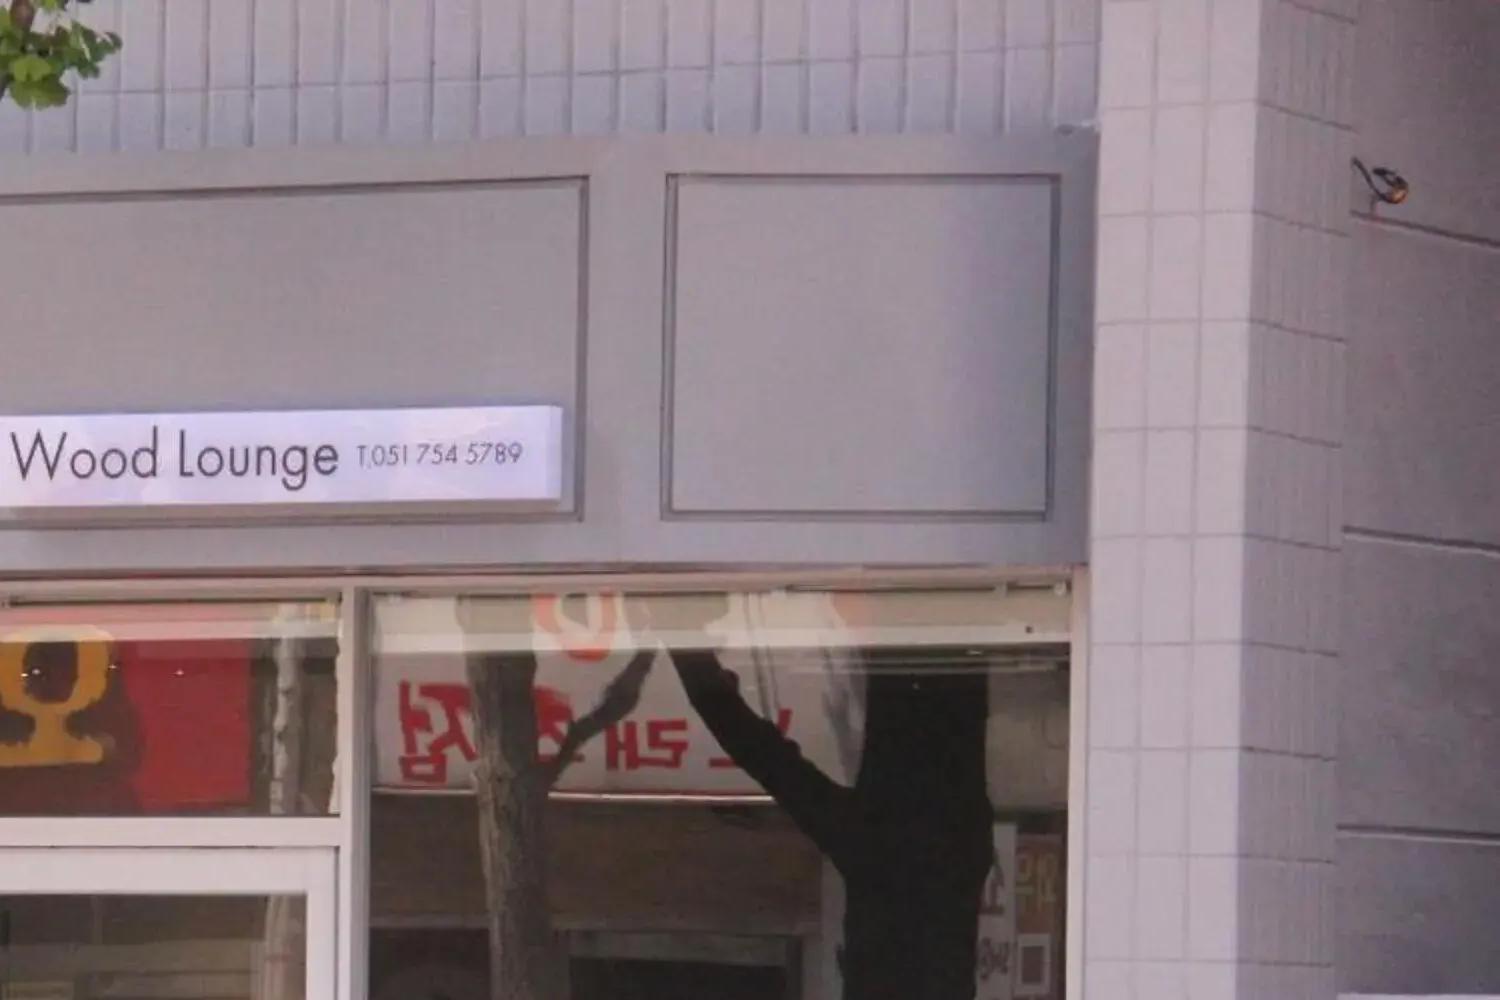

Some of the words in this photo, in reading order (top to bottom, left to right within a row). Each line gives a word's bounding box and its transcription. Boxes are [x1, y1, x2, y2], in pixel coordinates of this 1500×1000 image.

[10, 425, 158, 481] Wood
[179, 428, 338, 491] Lounge
[417, 443, 458, 467] 754
[465, 442, 524, 466] 5789
